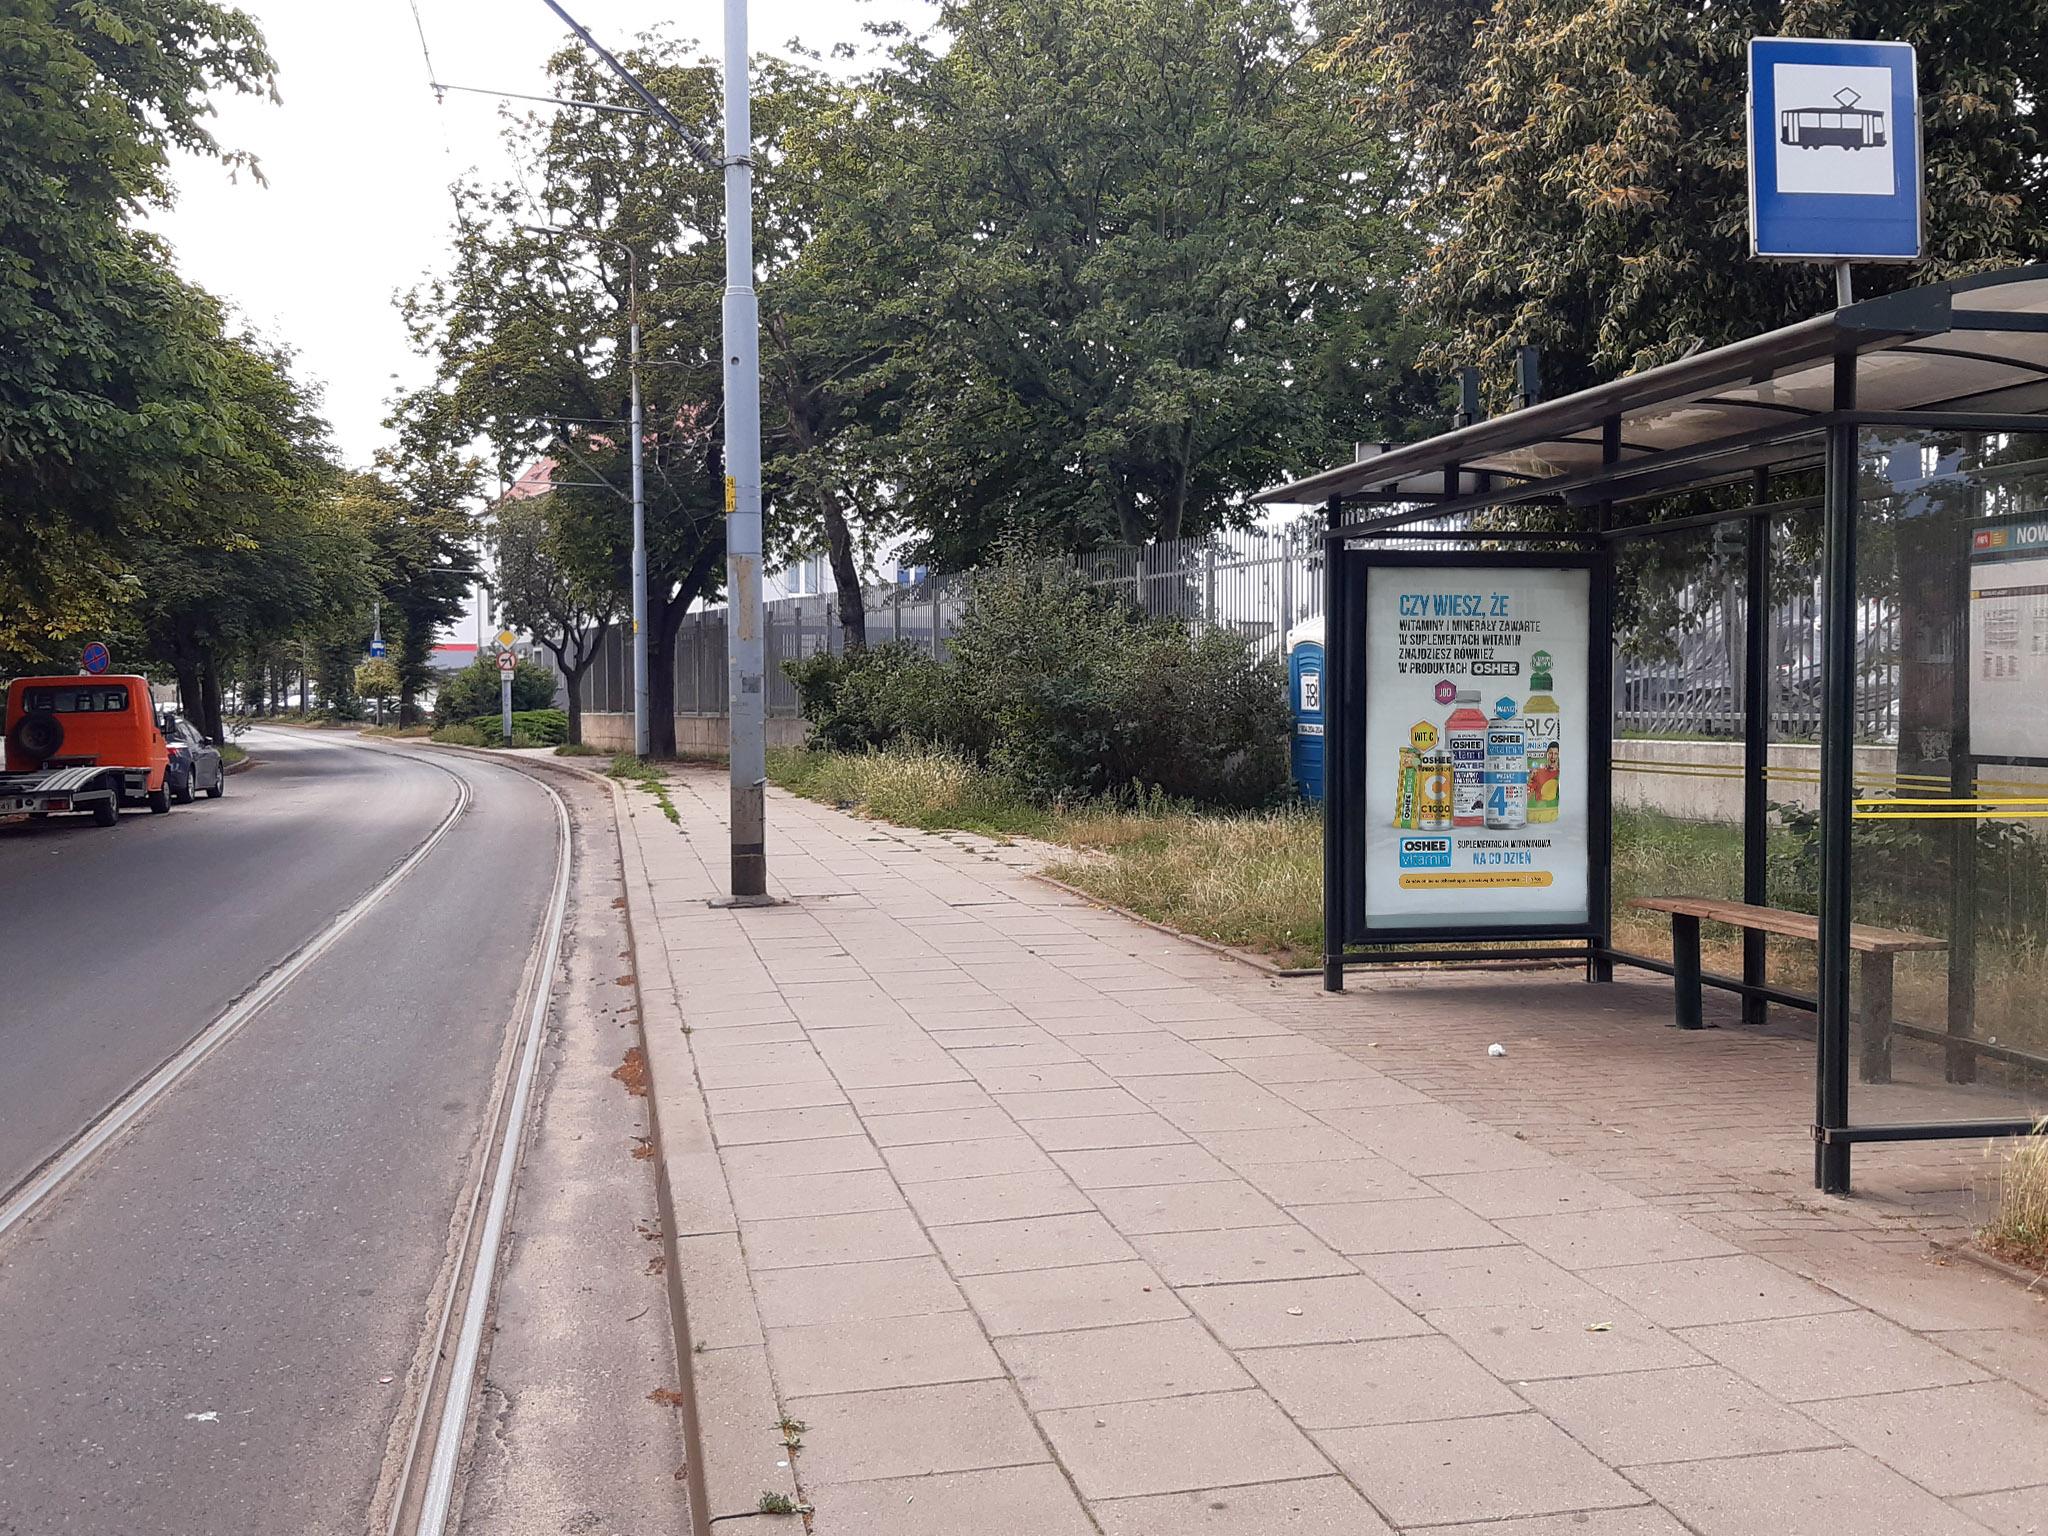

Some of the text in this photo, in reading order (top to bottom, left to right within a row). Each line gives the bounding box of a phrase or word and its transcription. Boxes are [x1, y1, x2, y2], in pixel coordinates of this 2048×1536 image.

[1399, 592, 1509, 619] CZY WIESZ, ŻE
[1399, 620, 1444, 631] WITAMINY
[1452, 620, 1497, 632] MINERAŁY
[1499, 620, 1541, 632] ZAWARTE
[1399, 634, 1521, 646] W SUPLEMENTACH WITAMIN
[1399, 646, 1495, 660] ZNAJDZIESZ RÓWNIEŻ
[1399, 662, 1518, 674] W PRODUKTACH OSHEE
[1439, 687, 1452, 697] JOD
[1414, 732, 1434, 742] WIT. C
[1490, 735, 1521, 743] OSHEE
[1453, 741, 1481, 749] OSHEE
[1488, 786, 1507, 816] 4
[1404, 841, 1446, 851] OSHEE
[1402, 853, 1450, 865] vitamin
[1473, 850, 1531, 865] NA CO DZIEŃ
